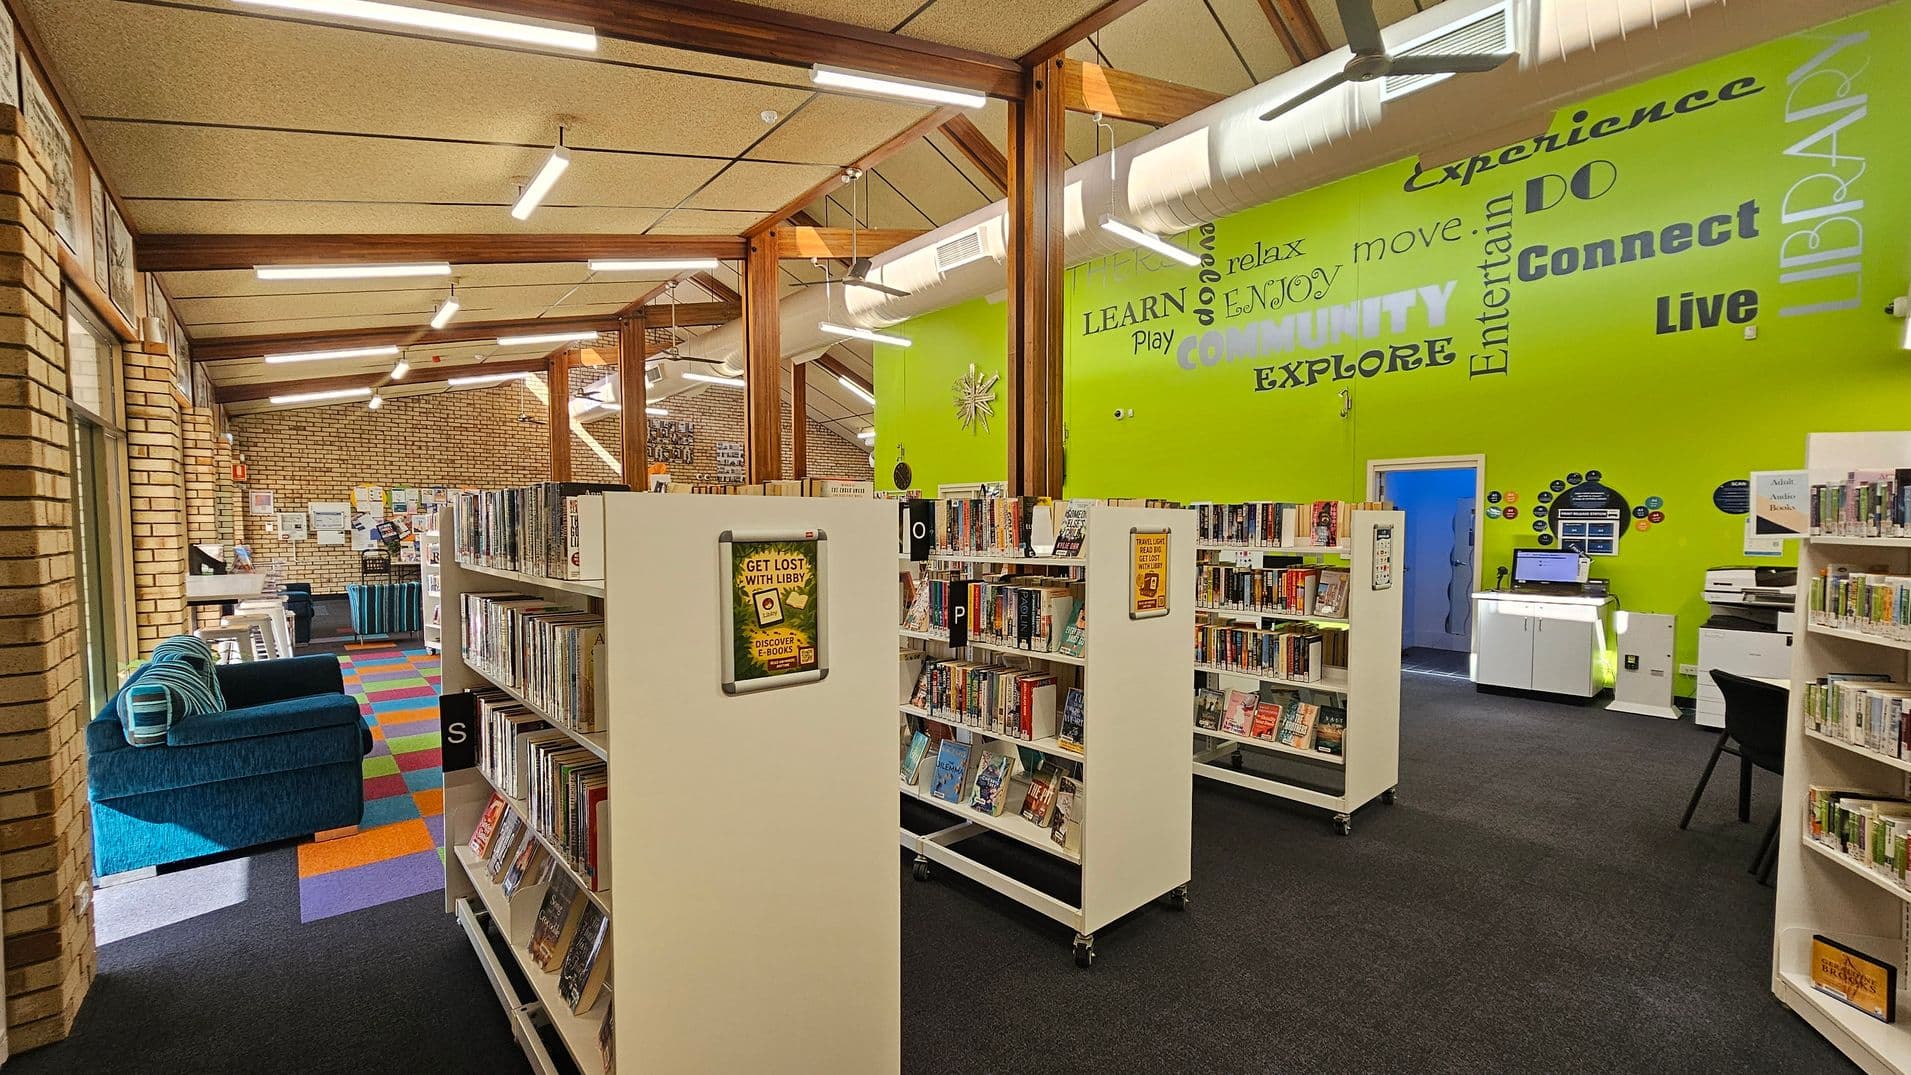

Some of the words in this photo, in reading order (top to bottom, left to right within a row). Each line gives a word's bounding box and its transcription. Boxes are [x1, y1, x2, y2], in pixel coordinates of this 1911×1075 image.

[1403, 76, 1766, 192] Experience
[1525, 159, 1617, 214] DO
[1517, 199, 1760, 283] Connect
[1226, 238, 1306, 275] relax
[1223, 265, 1343, 319] ENJOY
[1470, 191, 1514, 381] Entertain
[1083, 287, 1187, 336] LEARN
[1655, 289, 1758, 335] Live
[1176, 280, 1458, 370] COMMUNITY
[1132, 329, 1174, 355] Play
[1254, 336, 1457, 392] EXPLORE
[1770, 478, 1794, 486] Adult
[1769, 504, 1796, 512] Books
[912, 521, 926, 539] O
[1136, 538, 1152, 546] TRAVEL
[1139, 546, 1153, 554] READ
[1148, 554, 1160, 562] LOST
[746, 560, 770, 572] GET
[774, 558, 804, 571] LOST
[745, 574, 773, 585] WITH
[776, 572, 805, 584] LIBBY
[955, 606, 965, 624] P
[755, 636, 795, 648] DISCOVER
[758, 645, 793, 656] E-BOOKS
[448, 722, 467, 744] S
[1821, 964, 1877, 993] BROOKS
